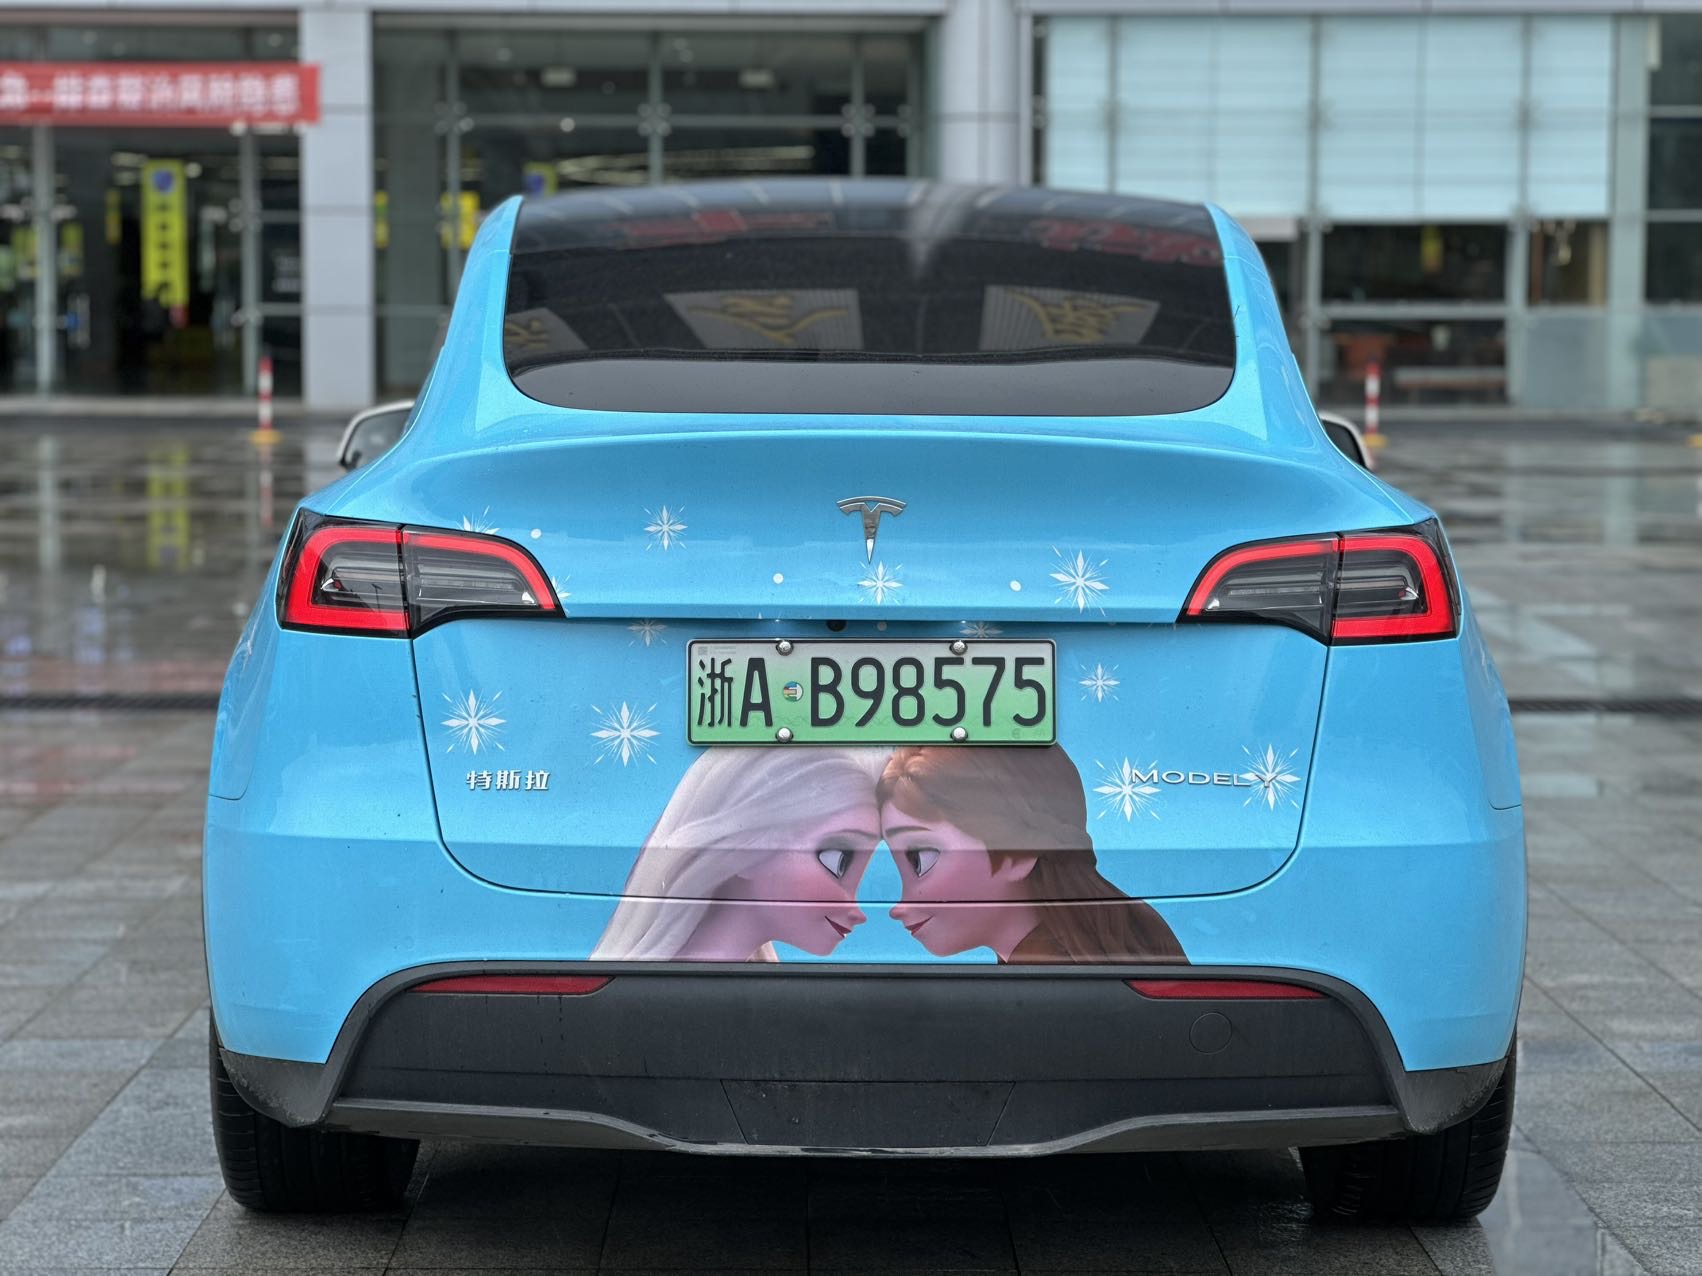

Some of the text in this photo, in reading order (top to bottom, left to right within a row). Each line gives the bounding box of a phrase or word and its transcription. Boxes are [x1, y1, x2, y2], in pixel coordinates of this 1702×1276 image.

[466, 769, 551, 791] 特斯拉
[1131, 768, 1278, 789] MODEL Y
